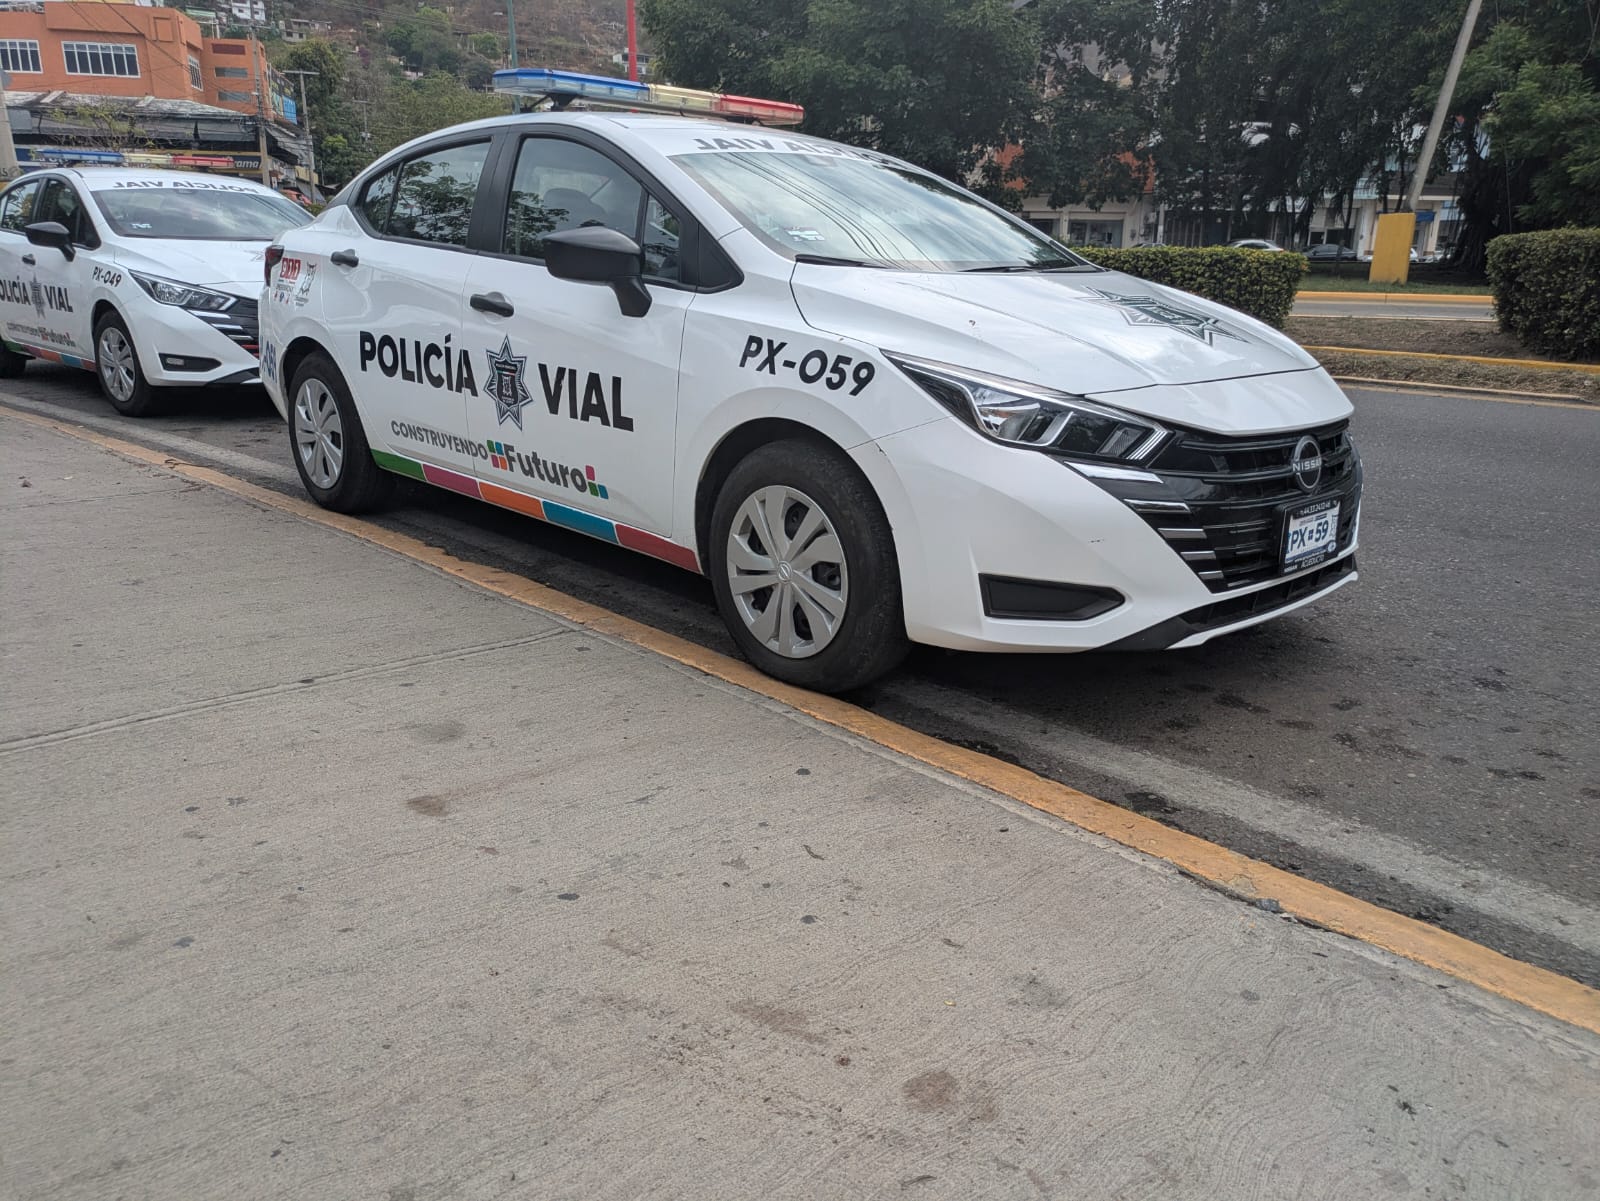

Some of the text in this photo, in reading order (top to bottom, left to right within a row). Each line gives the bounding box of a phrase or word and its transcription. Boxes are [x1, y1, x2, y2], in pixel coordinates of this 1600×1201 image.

[44, 284, 73, 313] VIAL
[93, 266, 122, 287] PX-049
[359, 330, 479, 397] POLICÍA
[537, 362, 634, 433] VIAL
[738, 334, 876, 397] PX-059
[390, 419, 588, 493] CONSTRUYENDO Futuro
